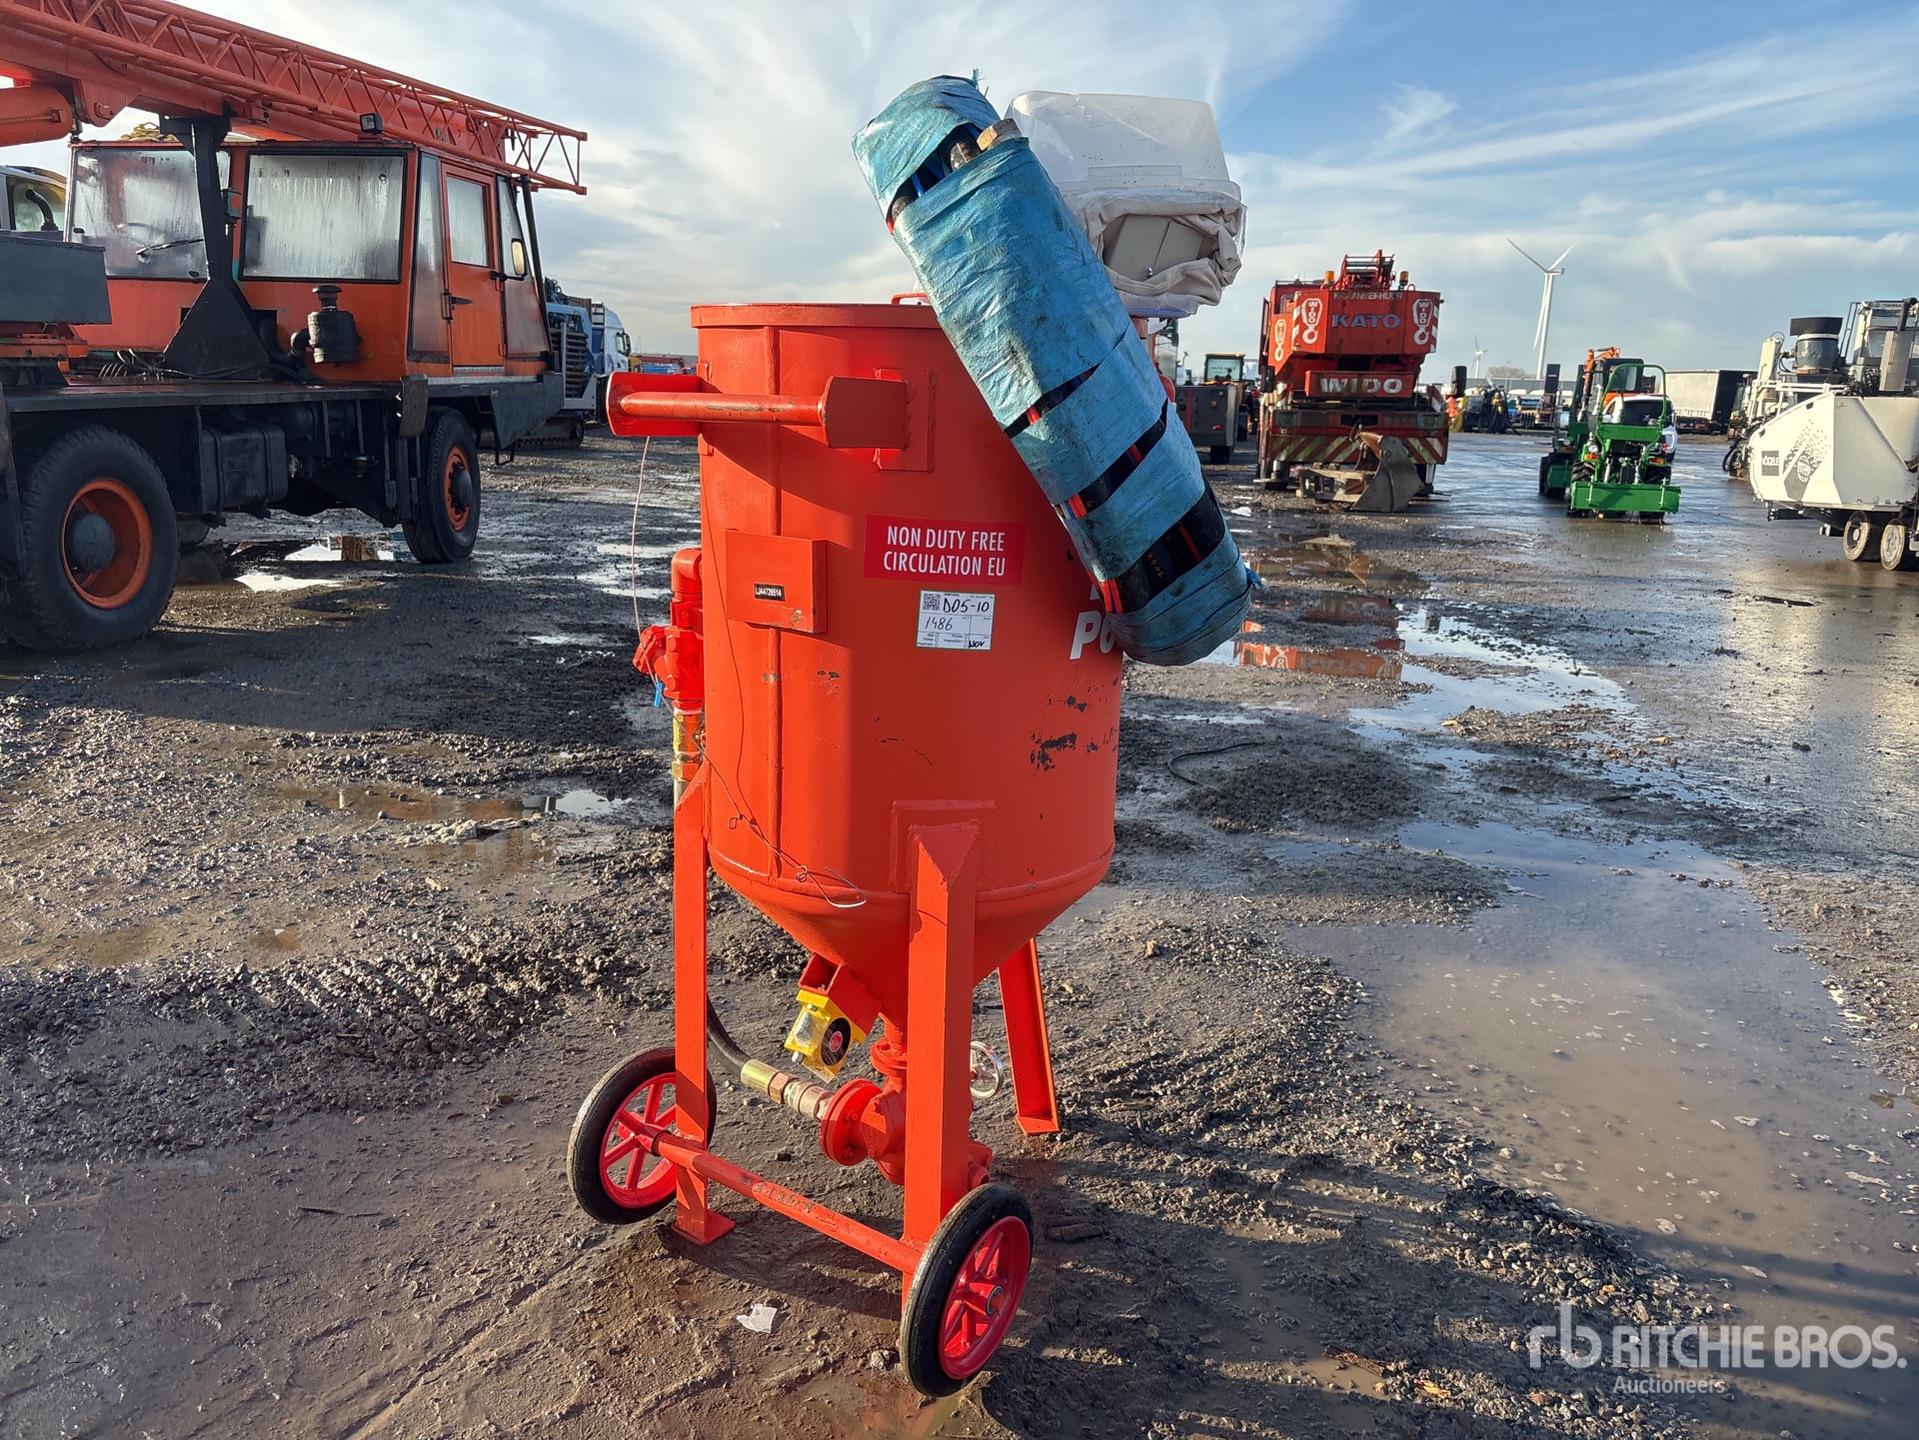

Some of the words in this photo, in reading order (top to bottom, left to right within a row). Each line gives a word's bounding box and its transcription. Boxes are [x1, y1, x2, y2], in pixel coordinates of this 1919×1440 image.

[1332, 313, 1401, 329] KATO
[1320, 378, 1403, 394] WIDO
[887, 525, 921, 548] NON
[925, 528, 967, 550] DUTY
[971, 531, 1005, 551] FREE
[883, 551, 981, 576] CIRCULATION
[987, 557, 1006, 577] EU
[924, 616, 953, 631] 1486
